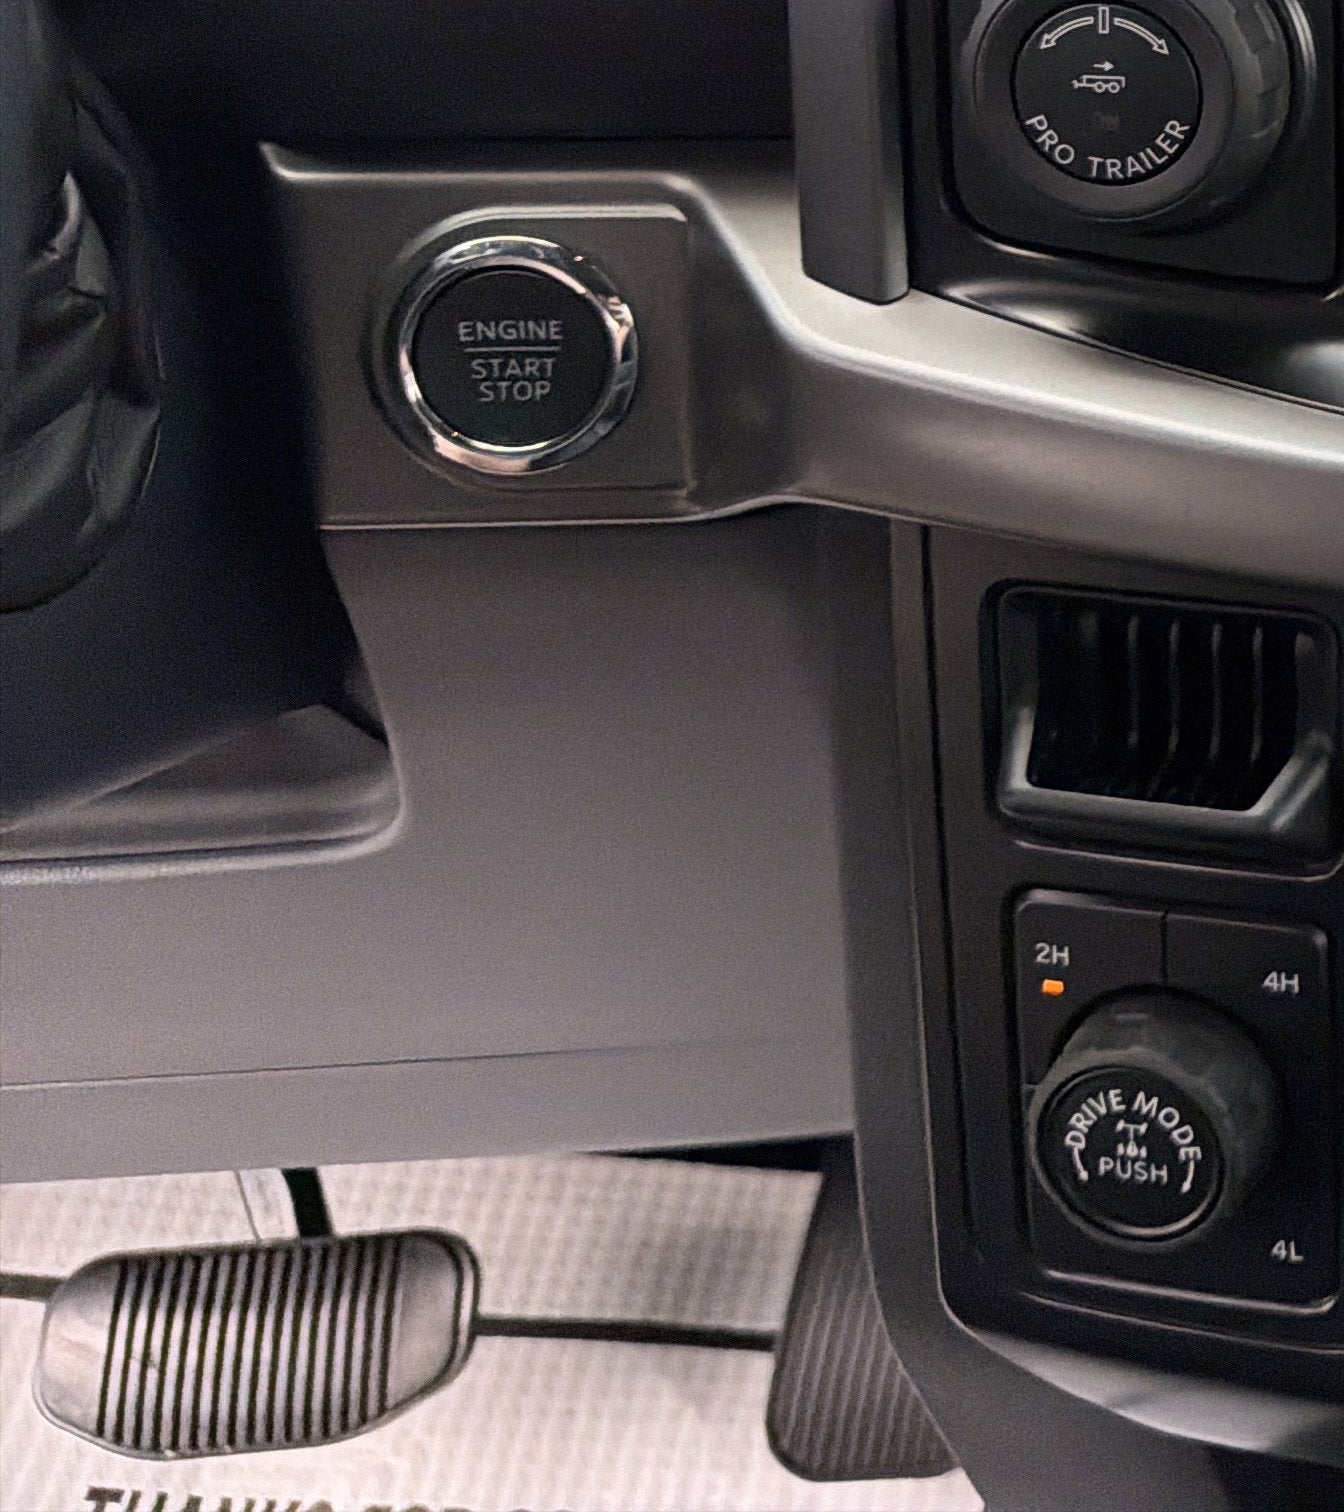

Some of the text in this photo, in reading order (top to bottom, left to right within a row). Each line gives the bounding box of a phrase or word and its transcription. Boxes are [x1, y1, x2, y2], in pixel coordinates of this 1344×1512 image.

[1025, 115, 1190, 179] PRO TRAILER
[458, 320, 562, 341] ENGINE
[472, 358, 556, 379] START
[479, 380, 551, 403] STOP
[1034, 942, 1070, 967] 2H
[1262, 970, 1300, 994] 4H
[1065, 1089, 1201, 1159] DRIVE MODE
[1098, 1156, 1168, 1185] PUSH
[1270, 1239, 1304, 1263] 4L
